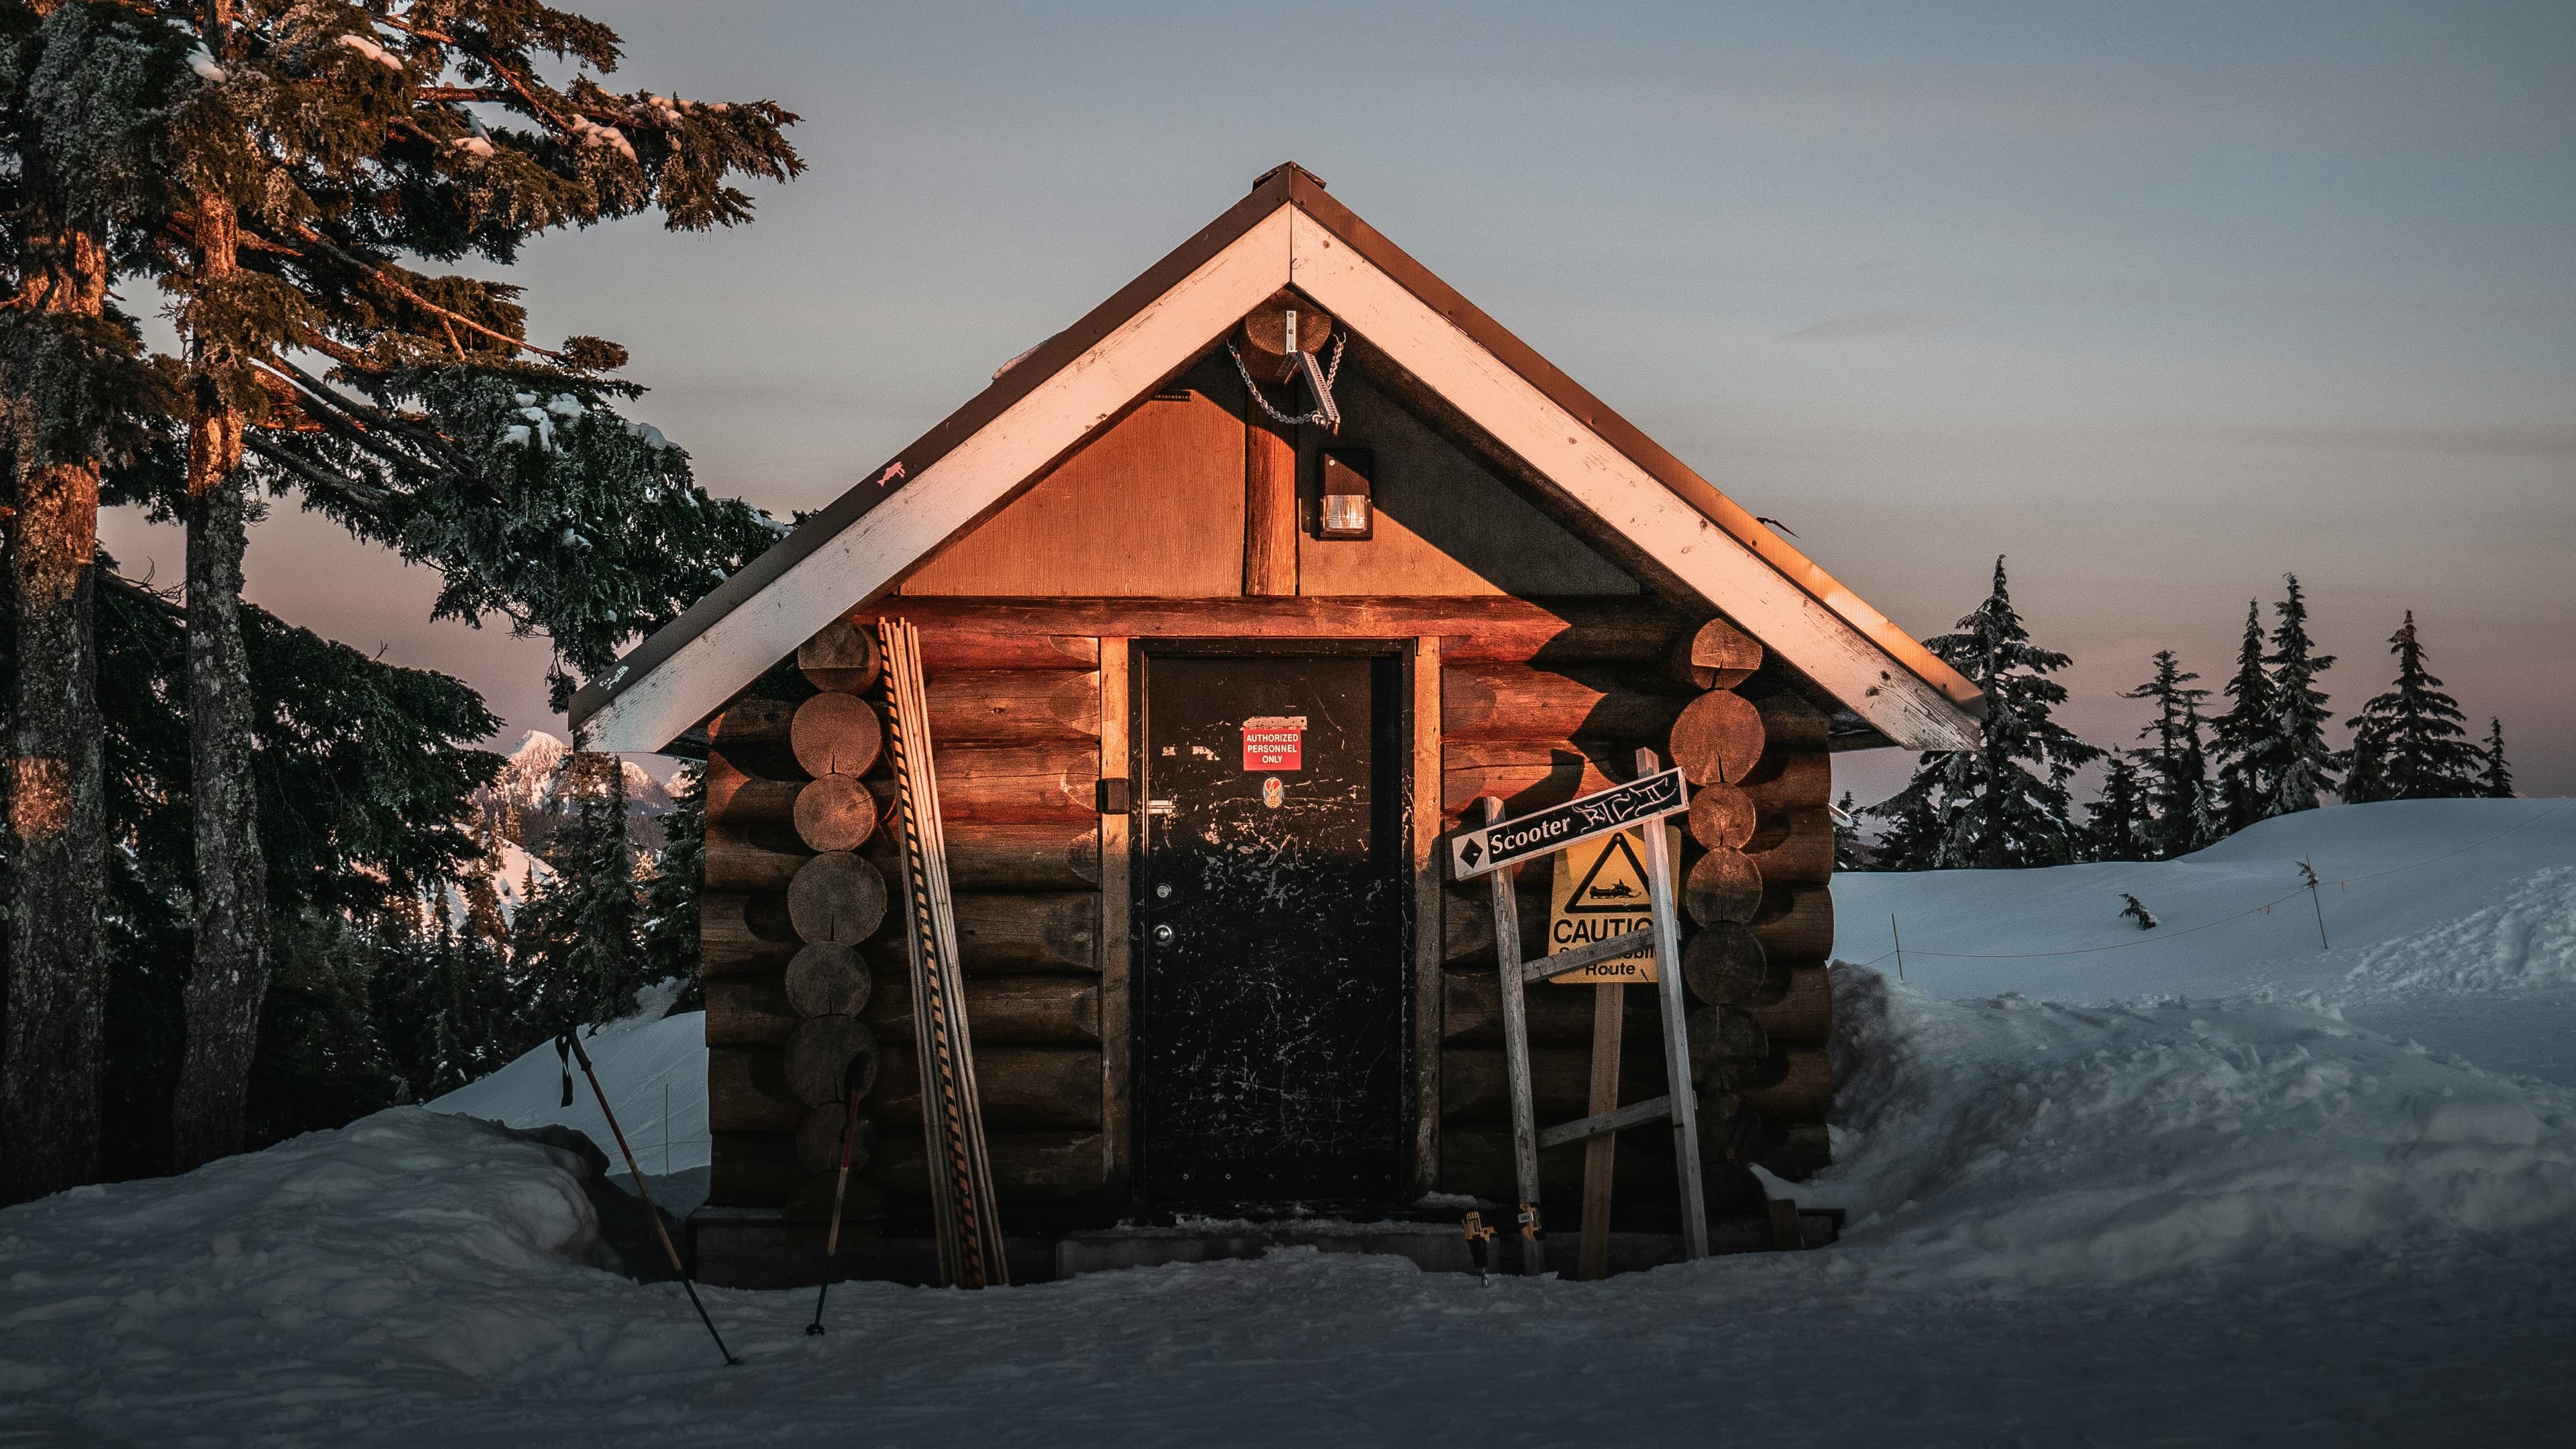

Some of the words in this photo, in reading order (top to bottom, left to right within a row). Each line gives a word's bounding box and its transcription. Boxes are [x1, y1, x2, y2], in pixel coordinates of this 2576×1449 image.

[1246, 734, 1299, 743] AUTHORIZED
[1247, 745, 1297, 753] PERSONNEL
[1262, 755, 1283, 763] ONLY
[1490, 817, 1570, 854] Scooter
[1553, 917, 1654, 944] CAUTI
[1585, 963, 1636, 975] Route
